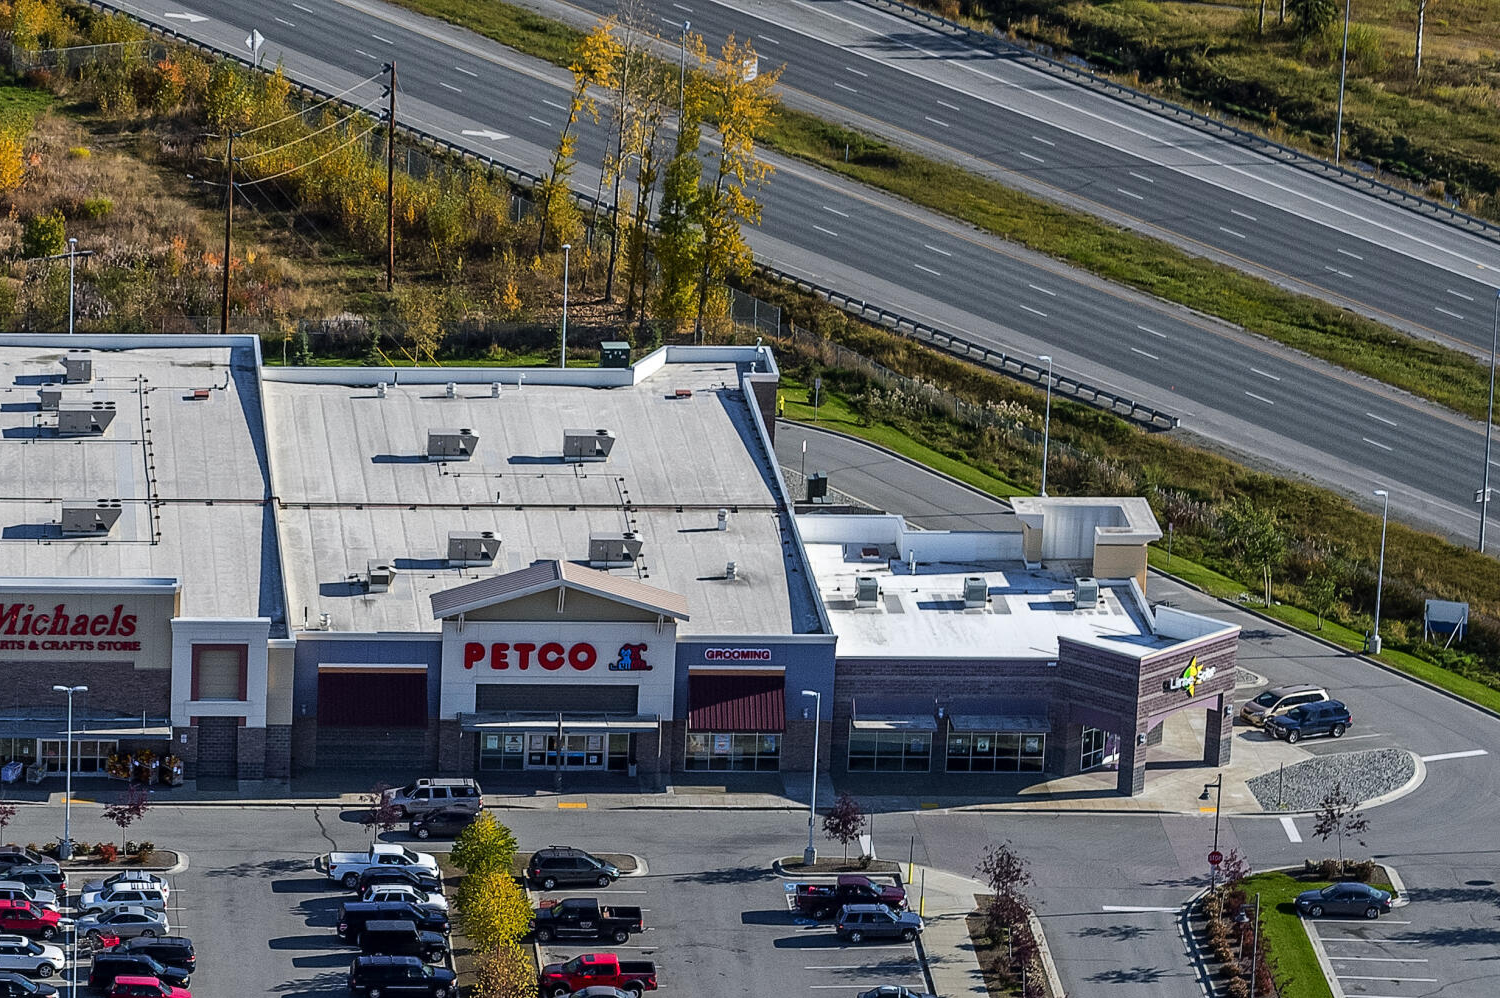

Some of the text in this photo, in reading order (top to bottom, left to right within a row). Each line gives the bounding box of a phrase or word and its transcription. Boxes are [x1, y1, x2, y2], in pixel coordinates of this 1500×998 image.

[28, 640, 40, 651] &
[41, 640, 95, 651] CRAFTS
[97, 641, 142, 651] STORE
[463, 642, 598, 671] PETCO
[705, 649, 771, 660] GROOMING
